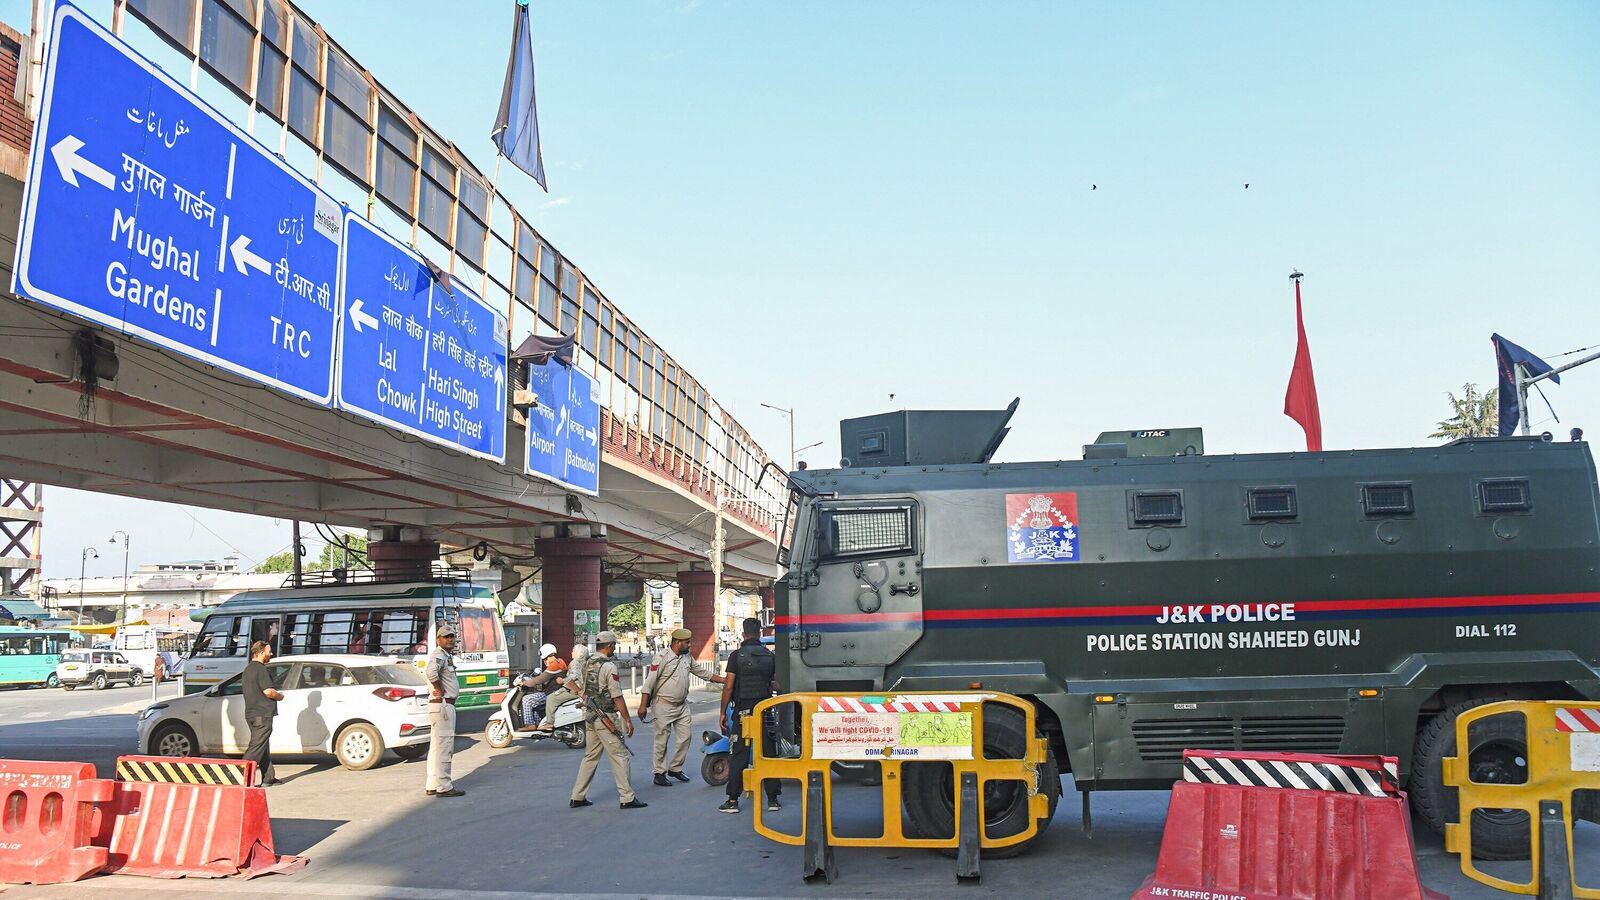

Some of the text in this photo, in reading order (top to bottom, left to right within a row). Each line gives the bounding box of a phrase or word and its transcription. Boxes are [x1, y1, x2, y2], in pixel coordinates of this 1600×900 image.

[121, 152, 217, 229] मुगल गार्डन
[110, 207, 200, 282] Mughal
[105, 260, 207, 332] Gardens
[270, 315, 312, 359] TRC
[382, 305, 424, 341] लाल चौक
[378, 342, 397, 372] Lal
[432, 330, 446, 354] हरी
[447, 336, 463, 363] सिंह
[377, 378, 417, 415] Chowk
[428, 368, 479, 410] Hari Singh
[425, 398, 482, 440] High Street
[1140, 430, 1166, 438] JTAC
[531, 431, 555, 456] Airport
[567, 449, 595, 474] Batmaloo
[1156, 603, 1296, 624] J&K POLICE
[1087, 629, 1361, 652] POLICE STATION SHAHEED GUNJ
[1455, 623, 1517, 638] DIAL 112
[889, 748, 919, 756] RINAGAR
[1150, 886, 1169, 897] J&K
[1171, 889, 1210, 900] TRAFFIC
